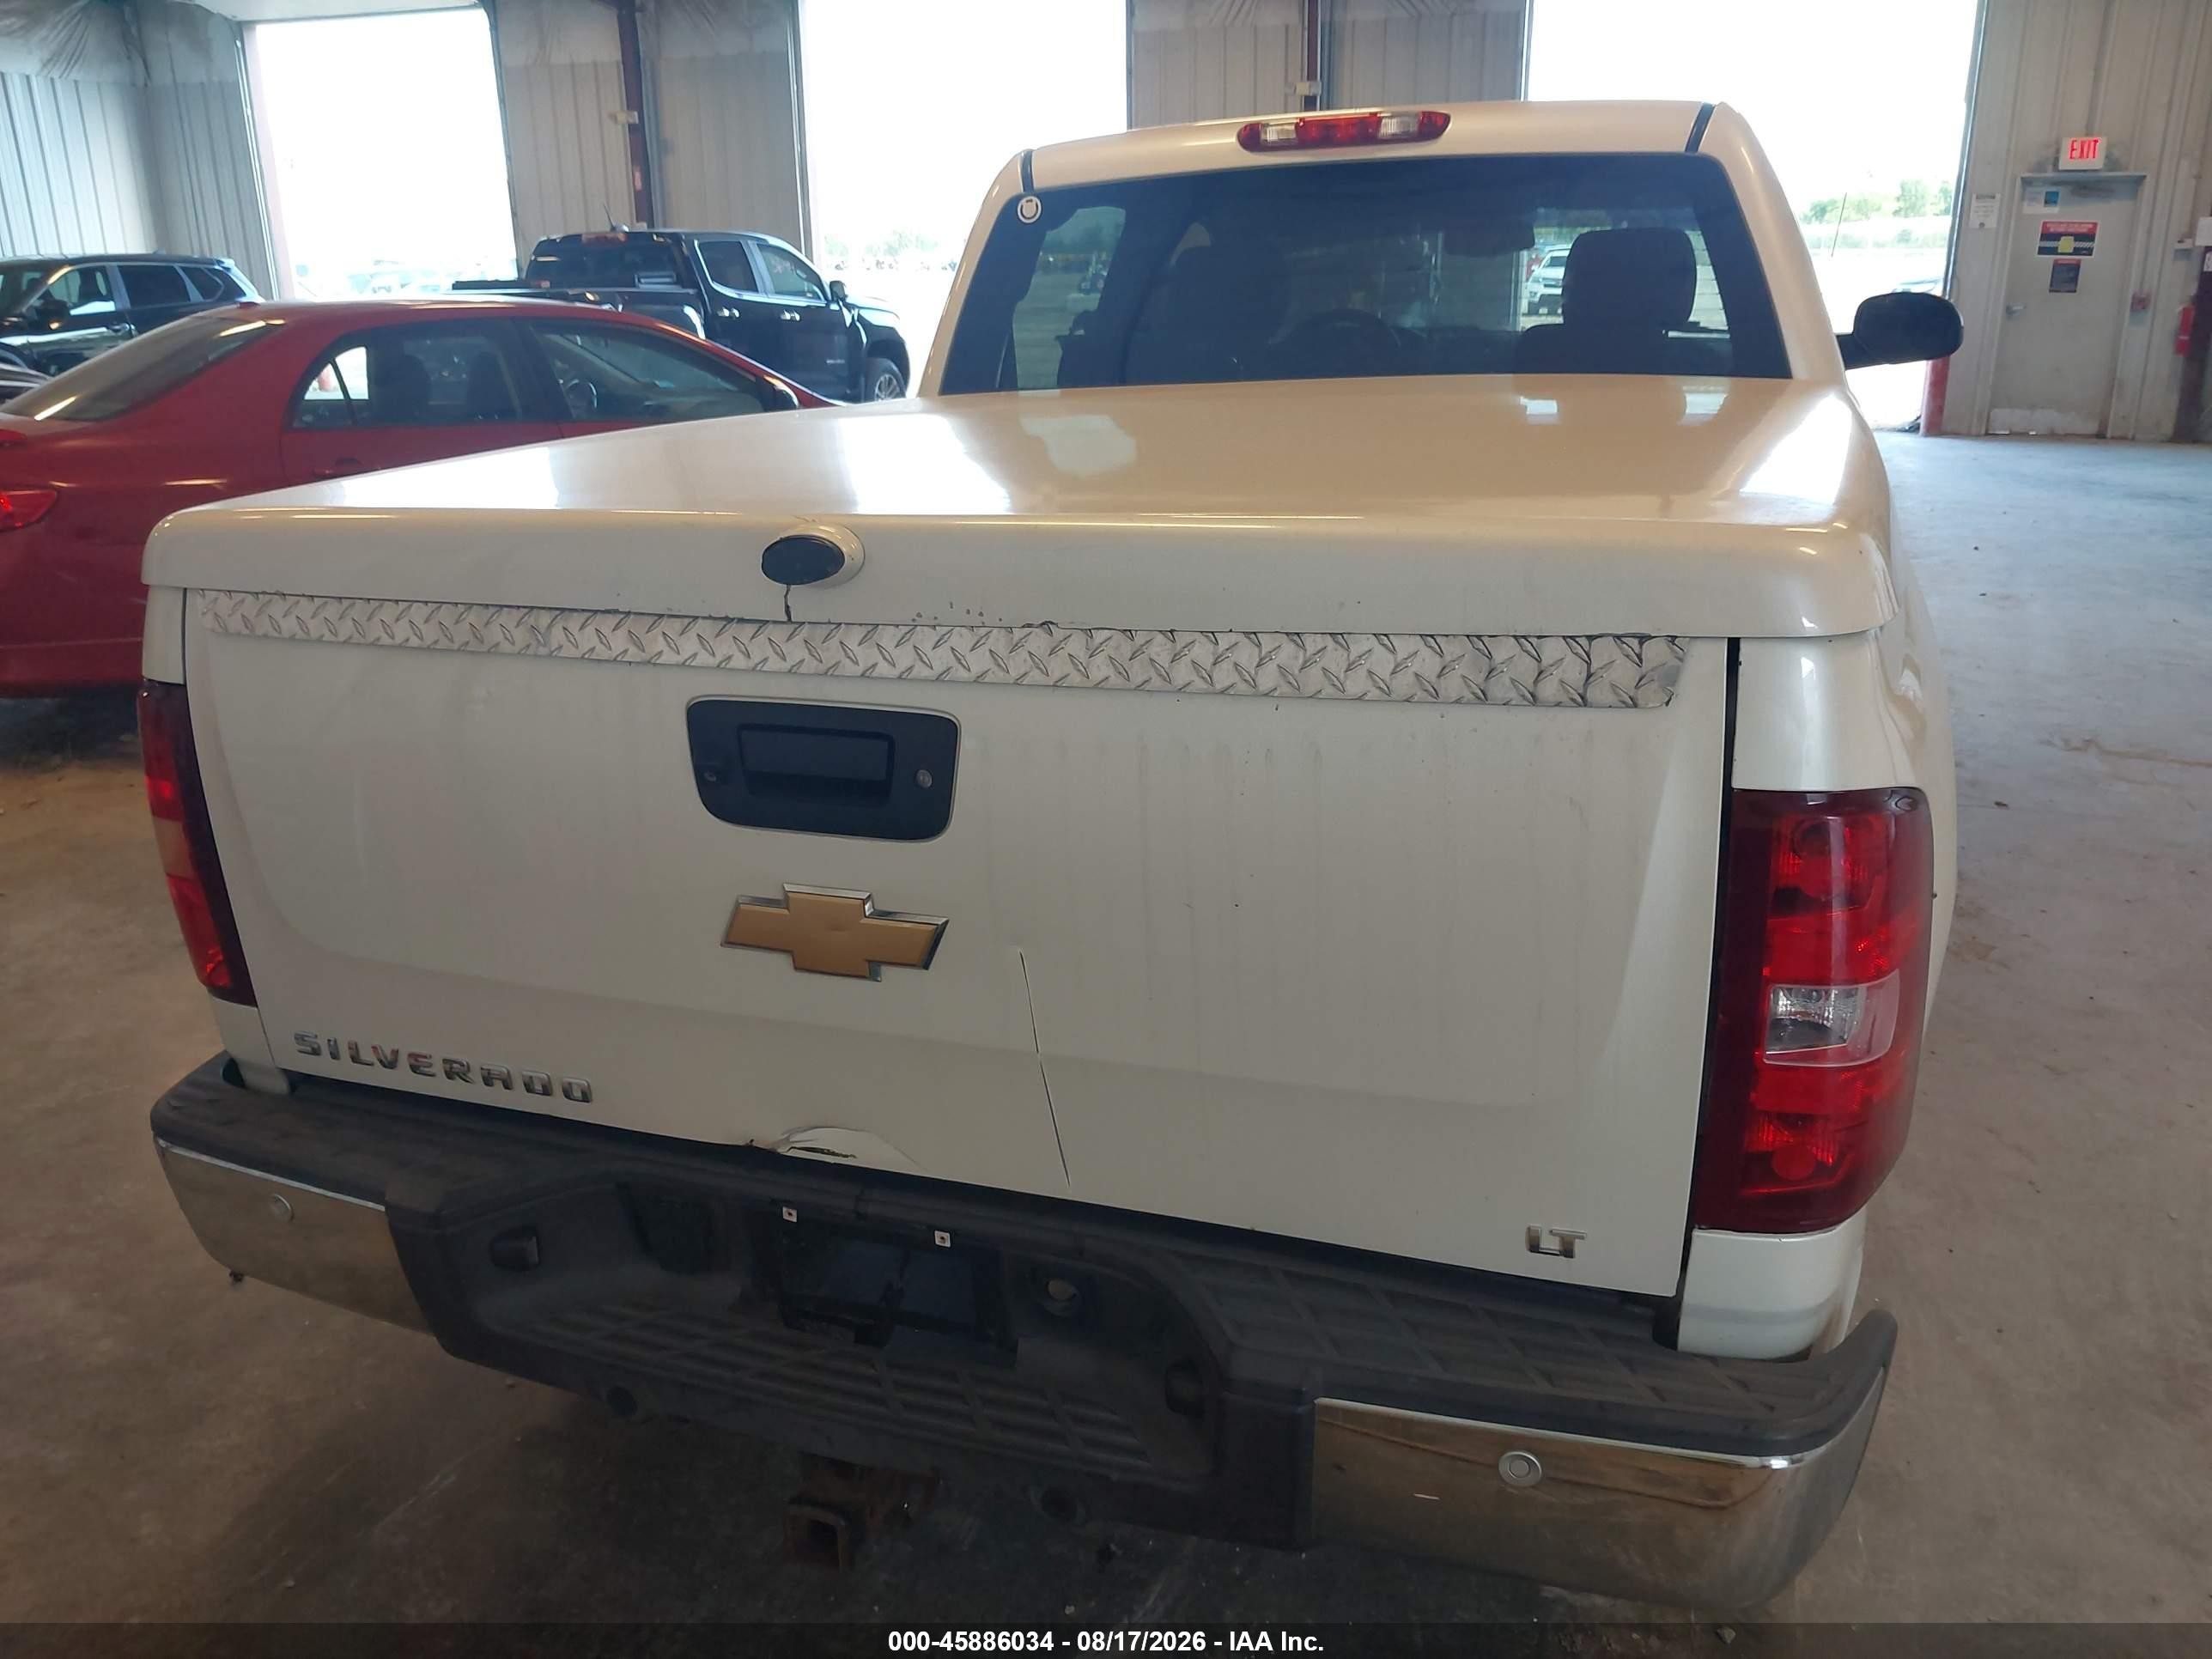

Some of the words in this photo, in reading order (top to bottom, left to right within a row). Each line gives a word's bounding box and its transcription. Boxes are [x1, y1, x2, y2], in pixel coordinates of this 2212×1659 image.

[2069, 139, 2100, 159] EXIT
[294, 1030, 593, 1104] SILVERADO
[1526, 1224, 1588, 1260] LT
